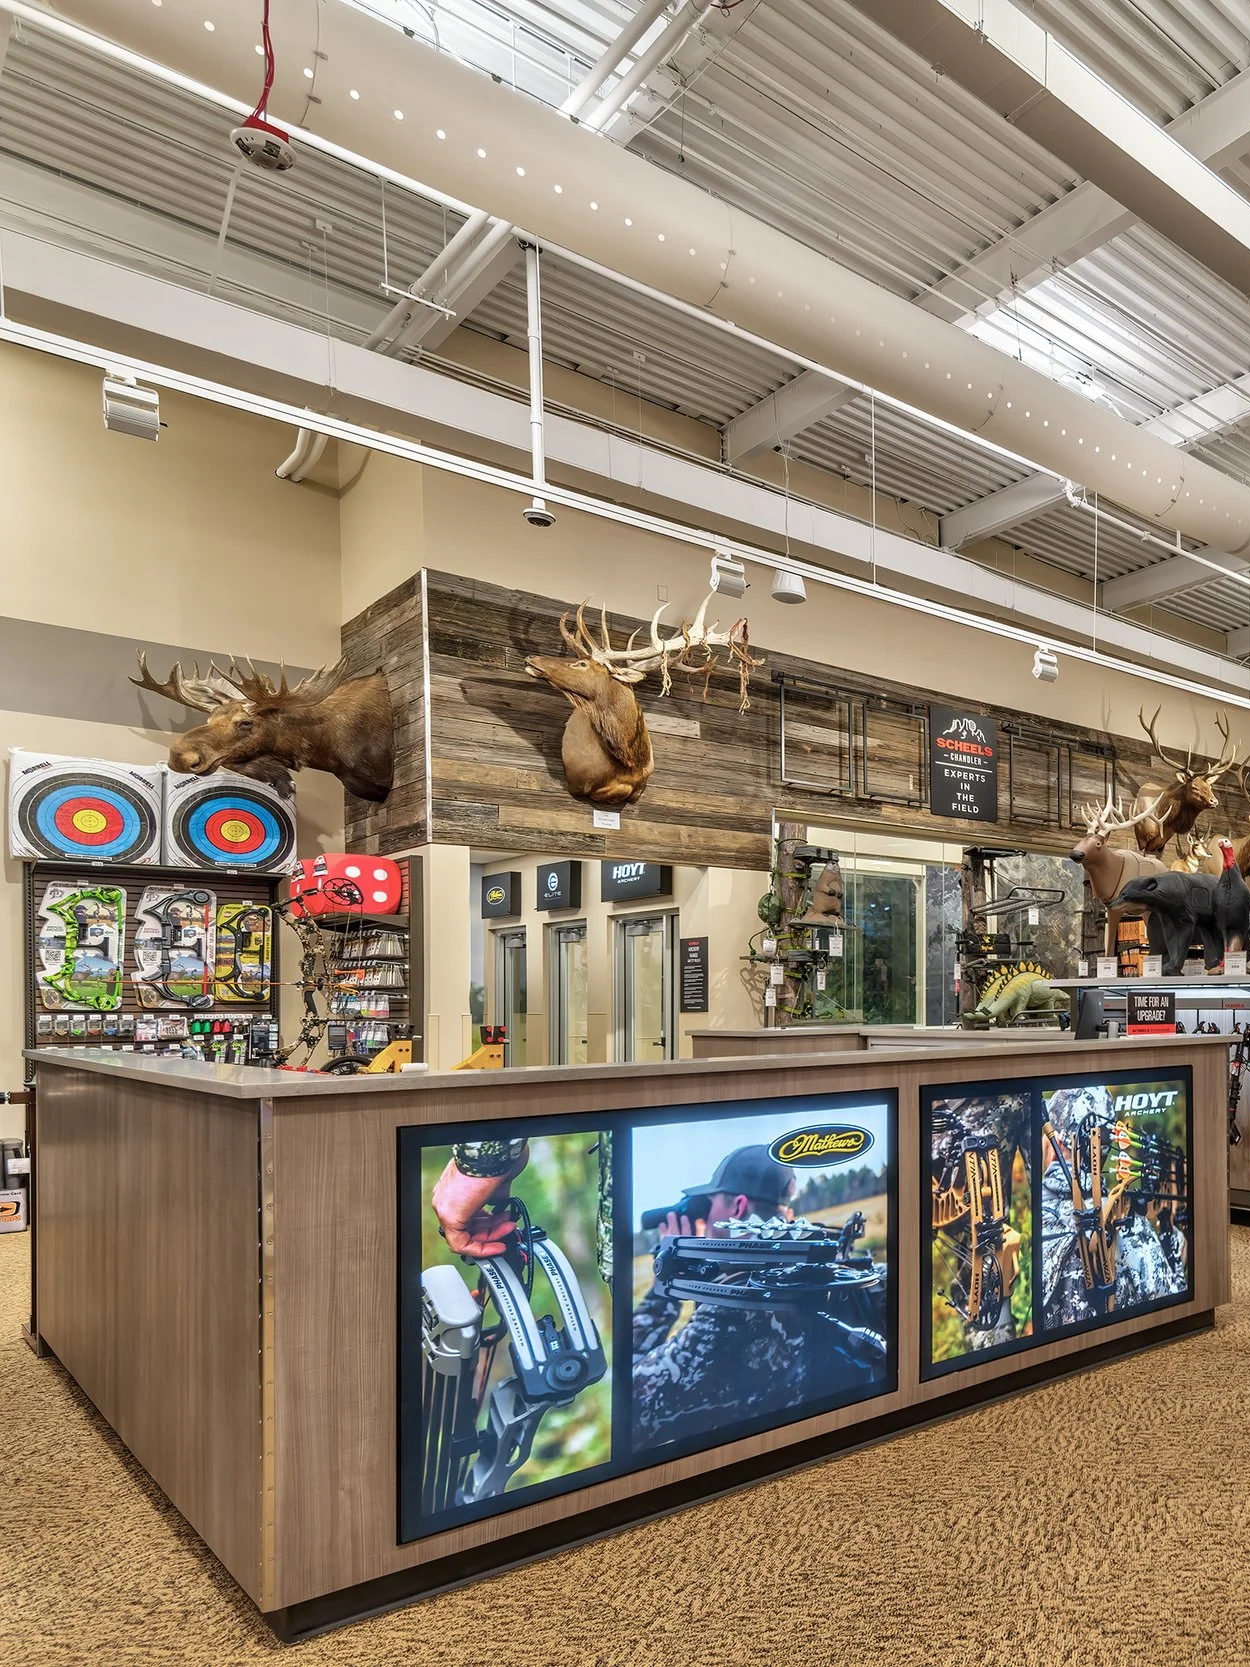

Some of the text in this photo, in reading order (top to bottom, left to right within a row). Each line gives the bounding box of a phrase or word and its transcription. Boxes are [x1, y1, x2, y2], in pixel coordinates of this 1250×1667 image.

[936, 737, 993, 757] SCHEELS
[950, 752, 982, 766] CHANDLER
[22, 761, 52, 775] MORRELL
[944, 768, 986, 783] EXPERTS
[129, 770, 155, 790] MORRELL
[174, 775, 200, 790] MORRELL
[960, 782, 971, 791] IN
[956, 792, 975, 803] THE
[952, 803, 979, 813] FIELD
[612, 863, 647, 879] HOYT
[1134, 996, 1169, 1007] TIME FOR AN
[1137, 1010, 1166, 1021] UPGRADE?
[1115, 1091, 1178, 1112] HOYT
[1124, 1107, 1167, 1117] ARCHERY
[778, 1130, 865, 1162] Mathews
[541, 1255, 559, 1276] PHASE
[486, 1267, 504, 1289] PHASE
